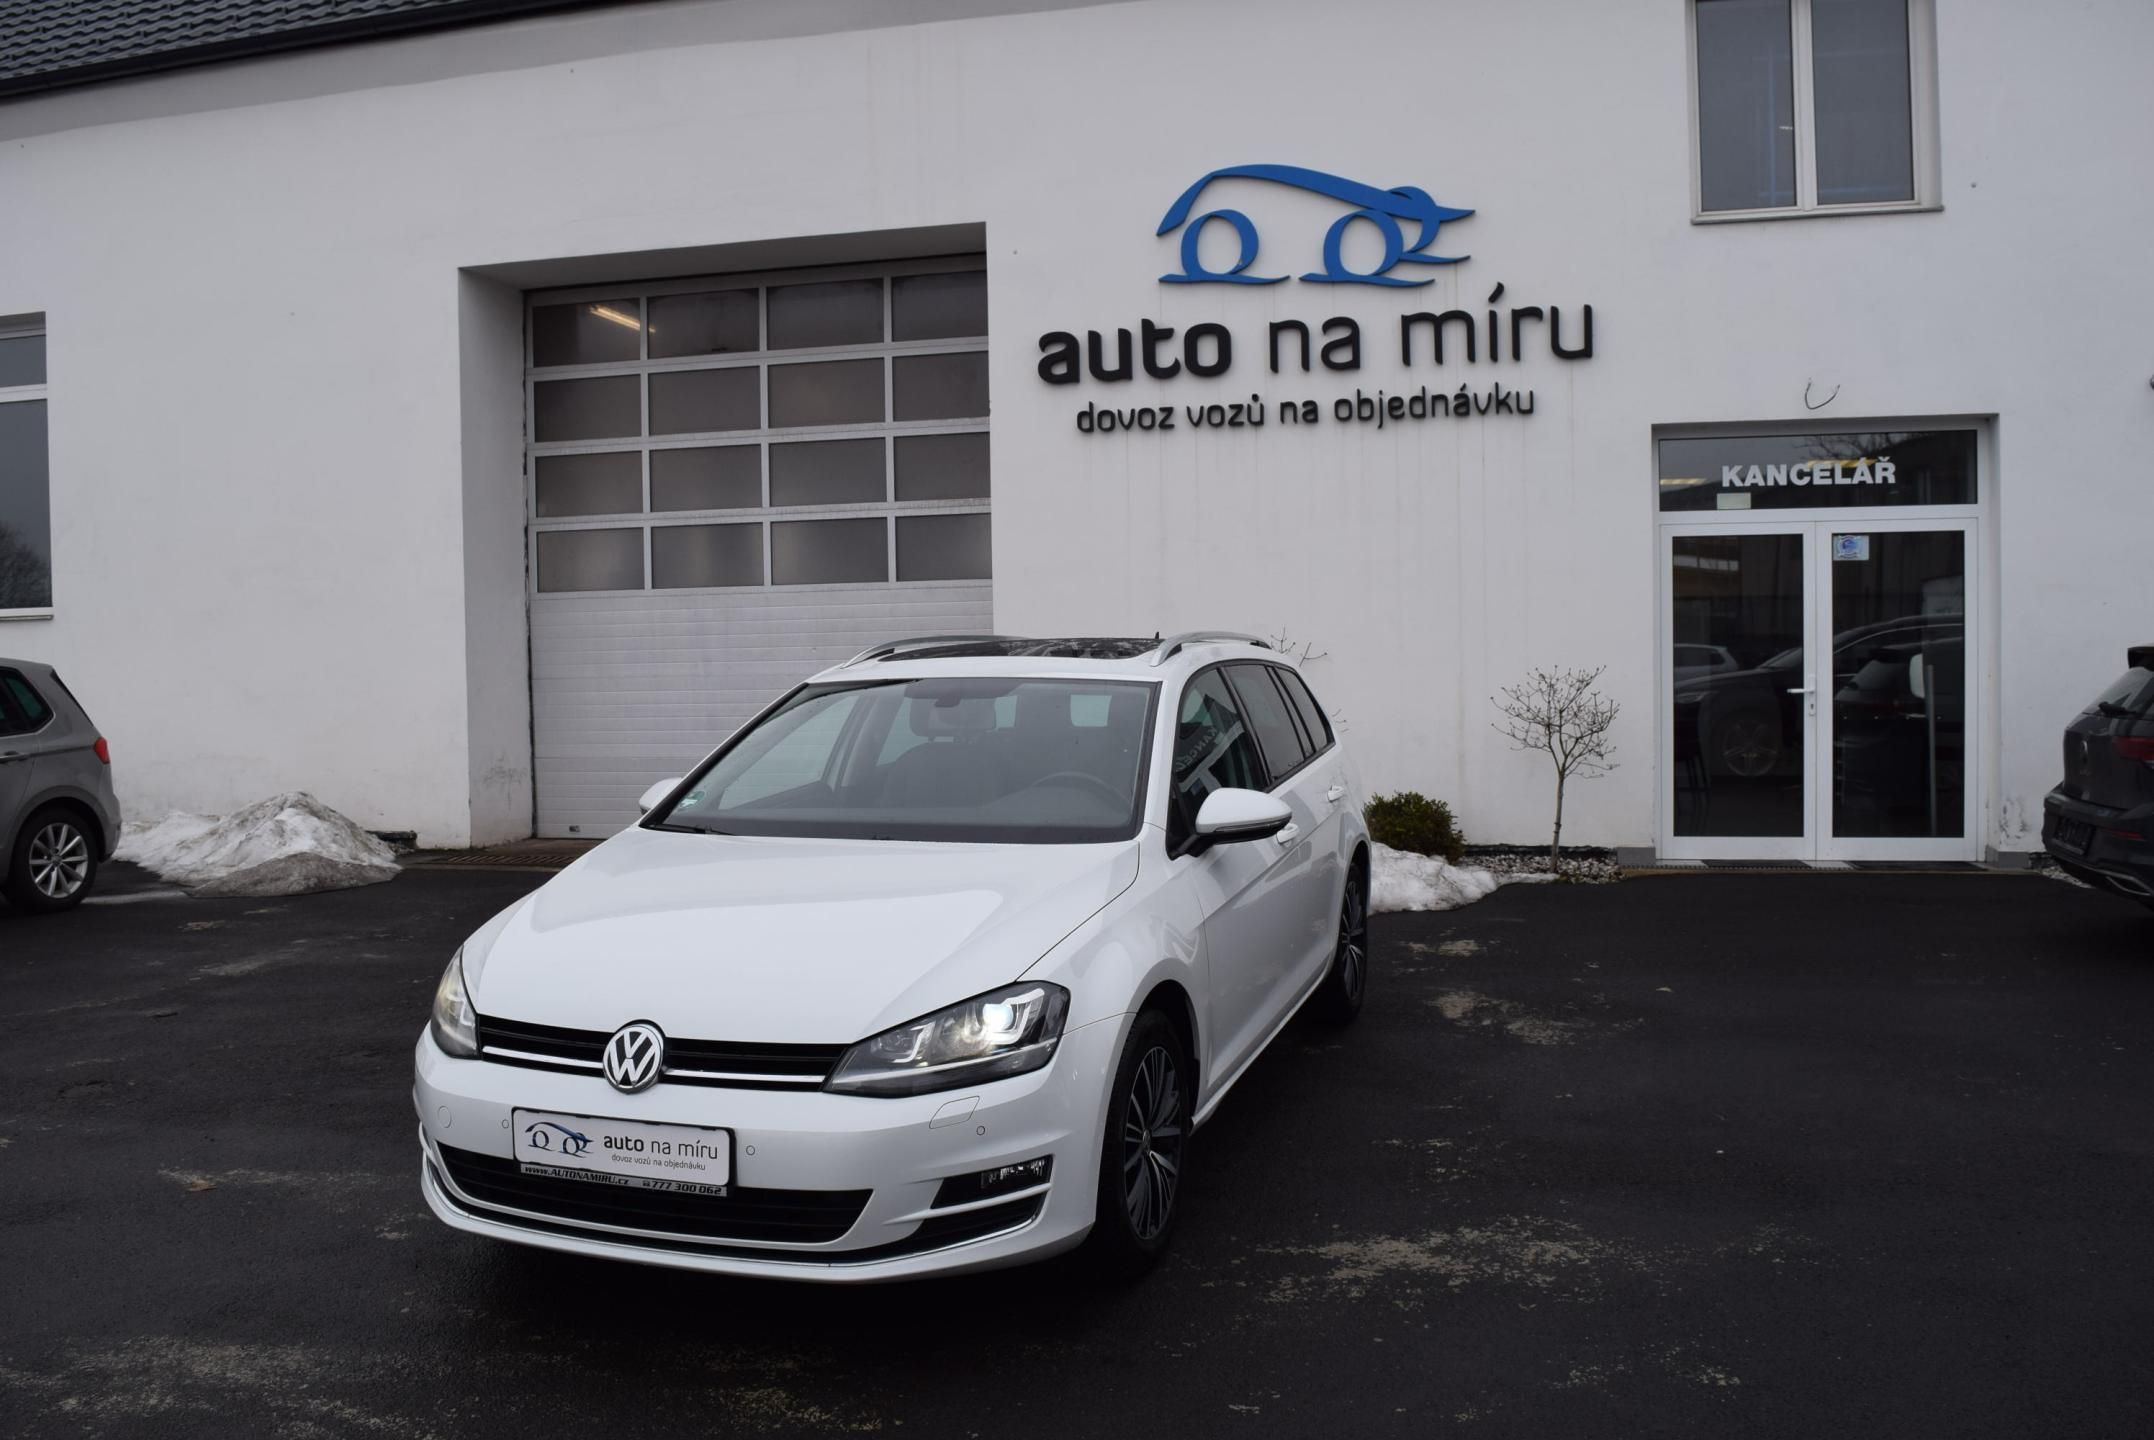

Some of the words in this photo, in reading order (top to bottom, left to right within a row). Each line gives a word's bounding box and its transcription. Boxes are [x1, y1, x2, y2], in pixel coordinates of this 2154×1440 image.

[1037, 318, 1232, 385] auto
[1269, 316, 1361, 374] na
[1400, 281, 1594, 367] míru
[1076, 401, 1176, 434] dovoz
[1186, 394, 1265, 429] vozů
[1279, 399, 1319, 426] na
[1333, 382, 1535, 430] objednávku
[1722, 457, 1896, 487] KANCELÁŘ
[603, 1135, 644, 1152] auto
[651, 1140, 671, 1155] na
[678, 1139, 718, 1160] míru
[611, 1153, 632, 1163] dovoz
[653, 1159, 662, 1167] na
[652, 1180, 673, 1190] 777
[674, 1183, 697, 1193] 300
[699, 1186, 722, 1195] 062
